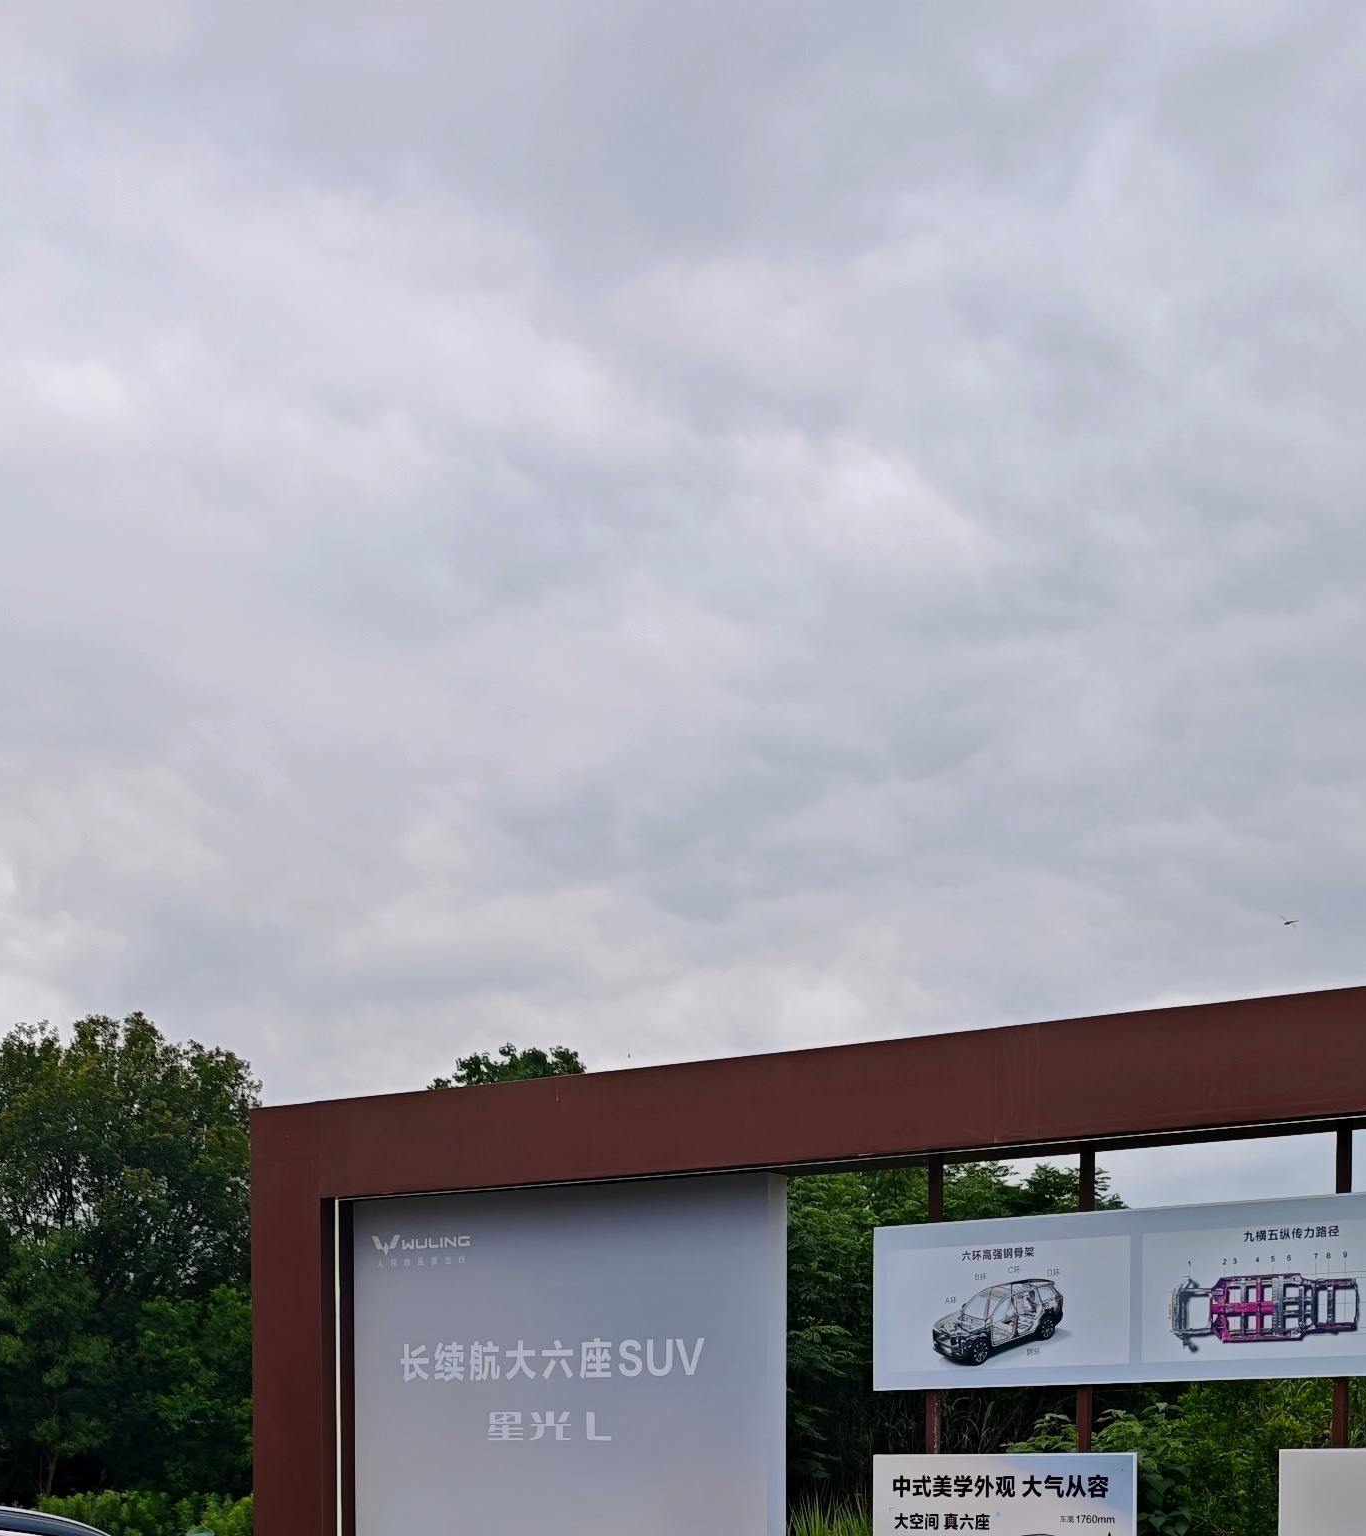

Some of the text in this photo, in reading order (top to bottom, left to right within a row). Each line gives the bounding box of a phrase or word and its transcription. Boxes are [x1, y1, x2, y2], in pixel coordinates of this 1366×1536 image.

[401, 1235, 471, 1250] WULING
[1243, 1225, 1340, 1243] 九横五纵传力路径
[961, 1246, 1035, 1262] 六环高强钢骨架
[1232, 1257, 1238, 1265] 3
[1270, 1255, 1275, 1263] 5
[1286, 1254, 1292, 1262] 6
[1313, 1252, 1319, 1260] 7
[1325, 1252, 1331, 1260] 8
[1342, 1251, 1348, 1259] 9
[400, 1337, 706, 1383] 长续航大六座SUV
[892, 1474, 1110, 1499] 中式美学外观 大气从容
[894, 1513, 991, 1531] 大空间 真六座
[1075, 1514, 1116, 1525] 1760mm
